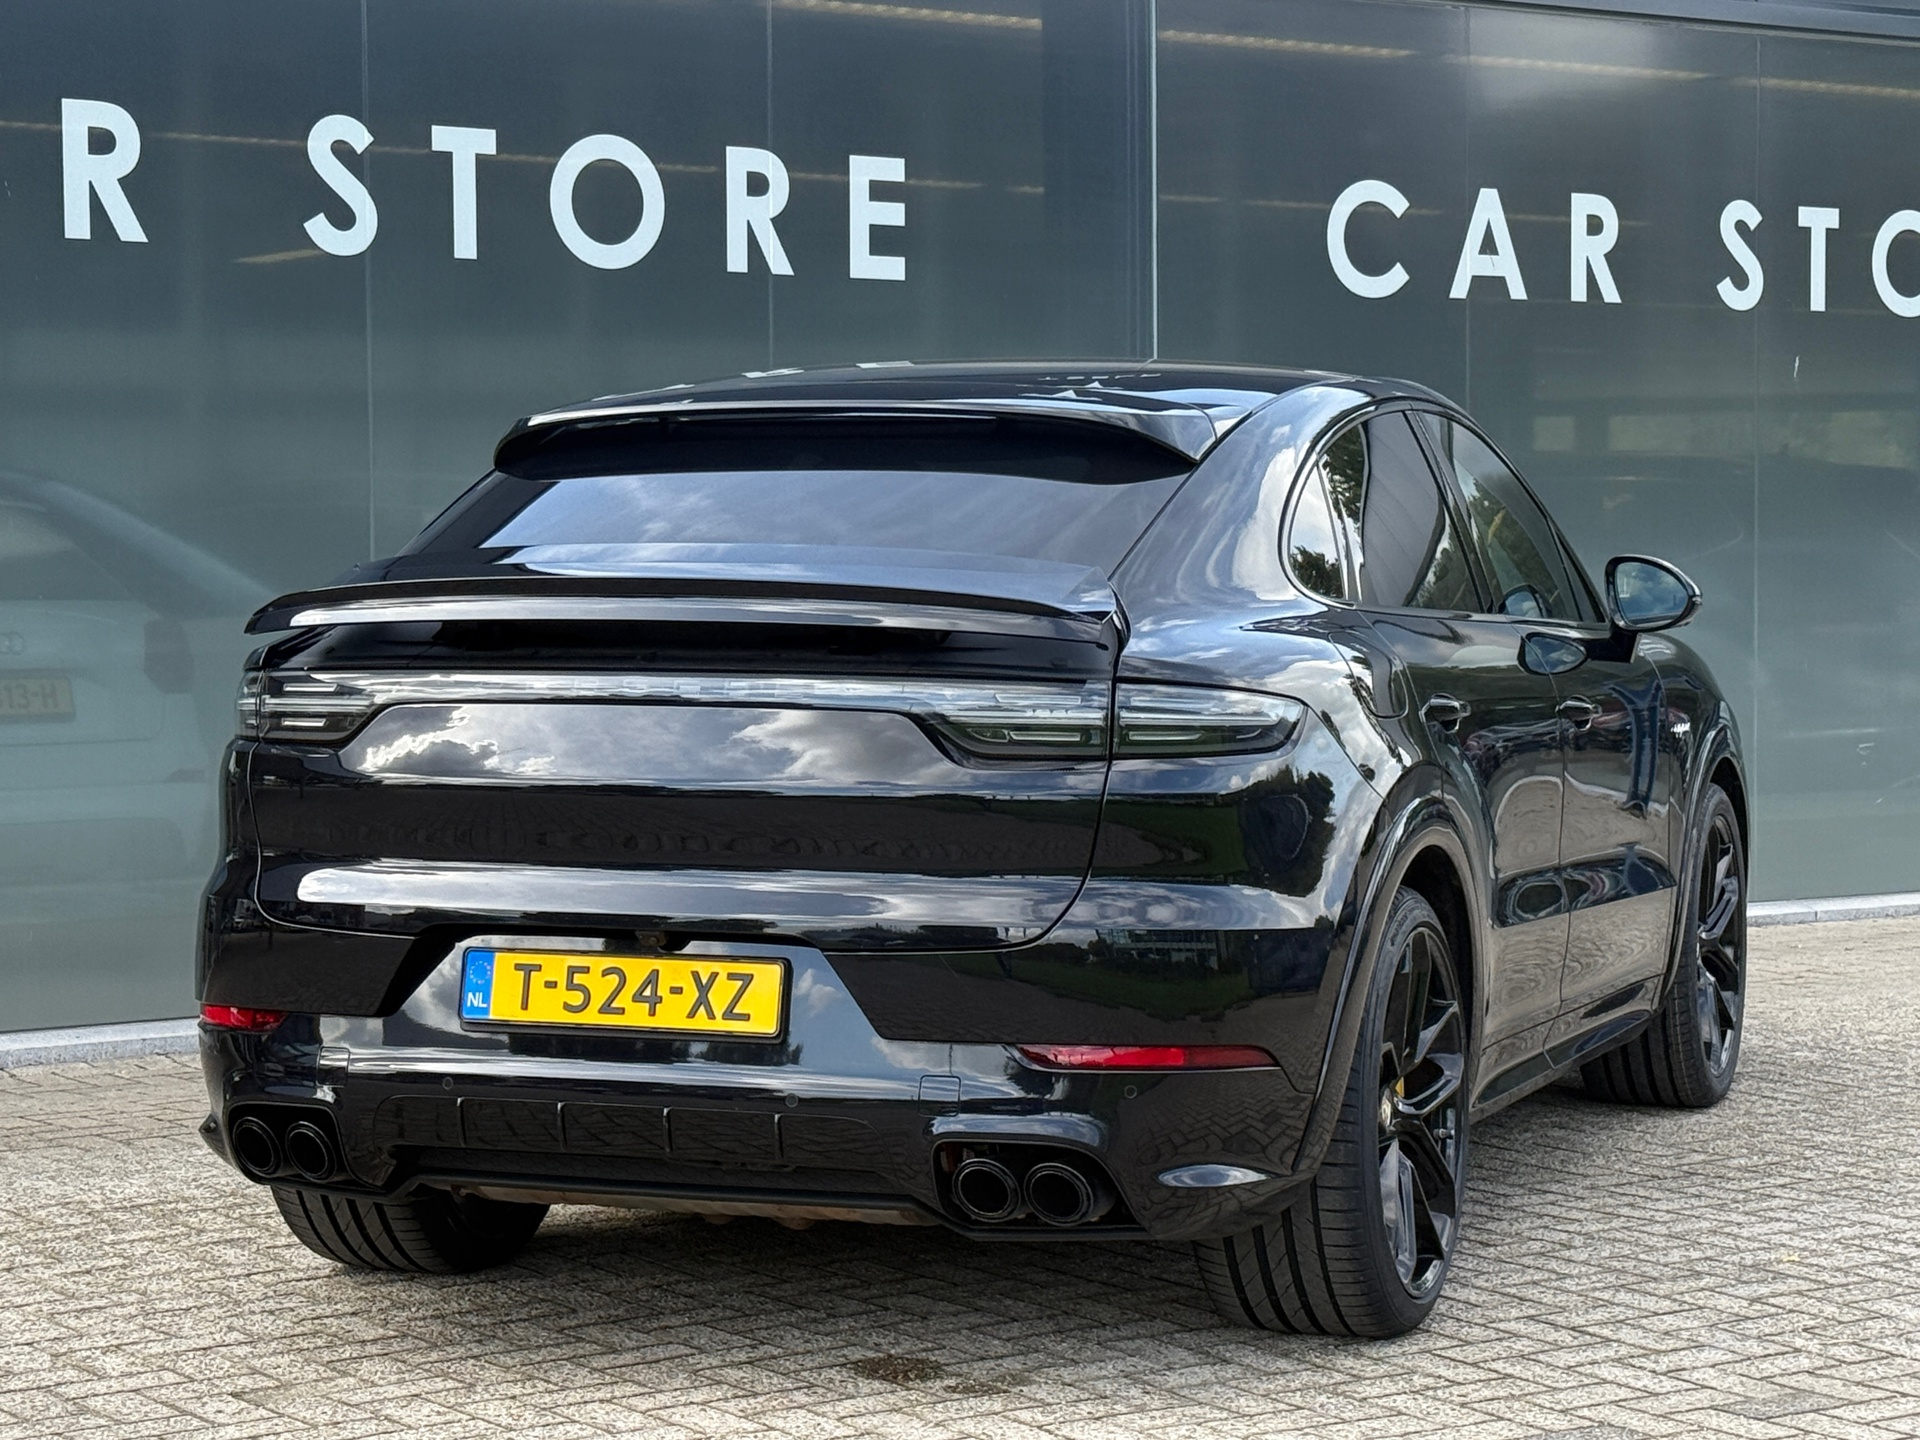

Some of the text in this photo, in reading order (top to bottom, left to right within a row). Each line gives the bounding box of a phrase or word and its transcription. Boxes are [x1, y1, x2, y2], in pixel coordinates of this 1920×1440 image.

[304, 115, 906, 281] STORE
[1327, 180, 1622, 303] CAR
[0, 682, 59, 709] 13-H
[467, 991, 488, 1008] NL
[514, 963, 754, 1022] T-524-XZ
